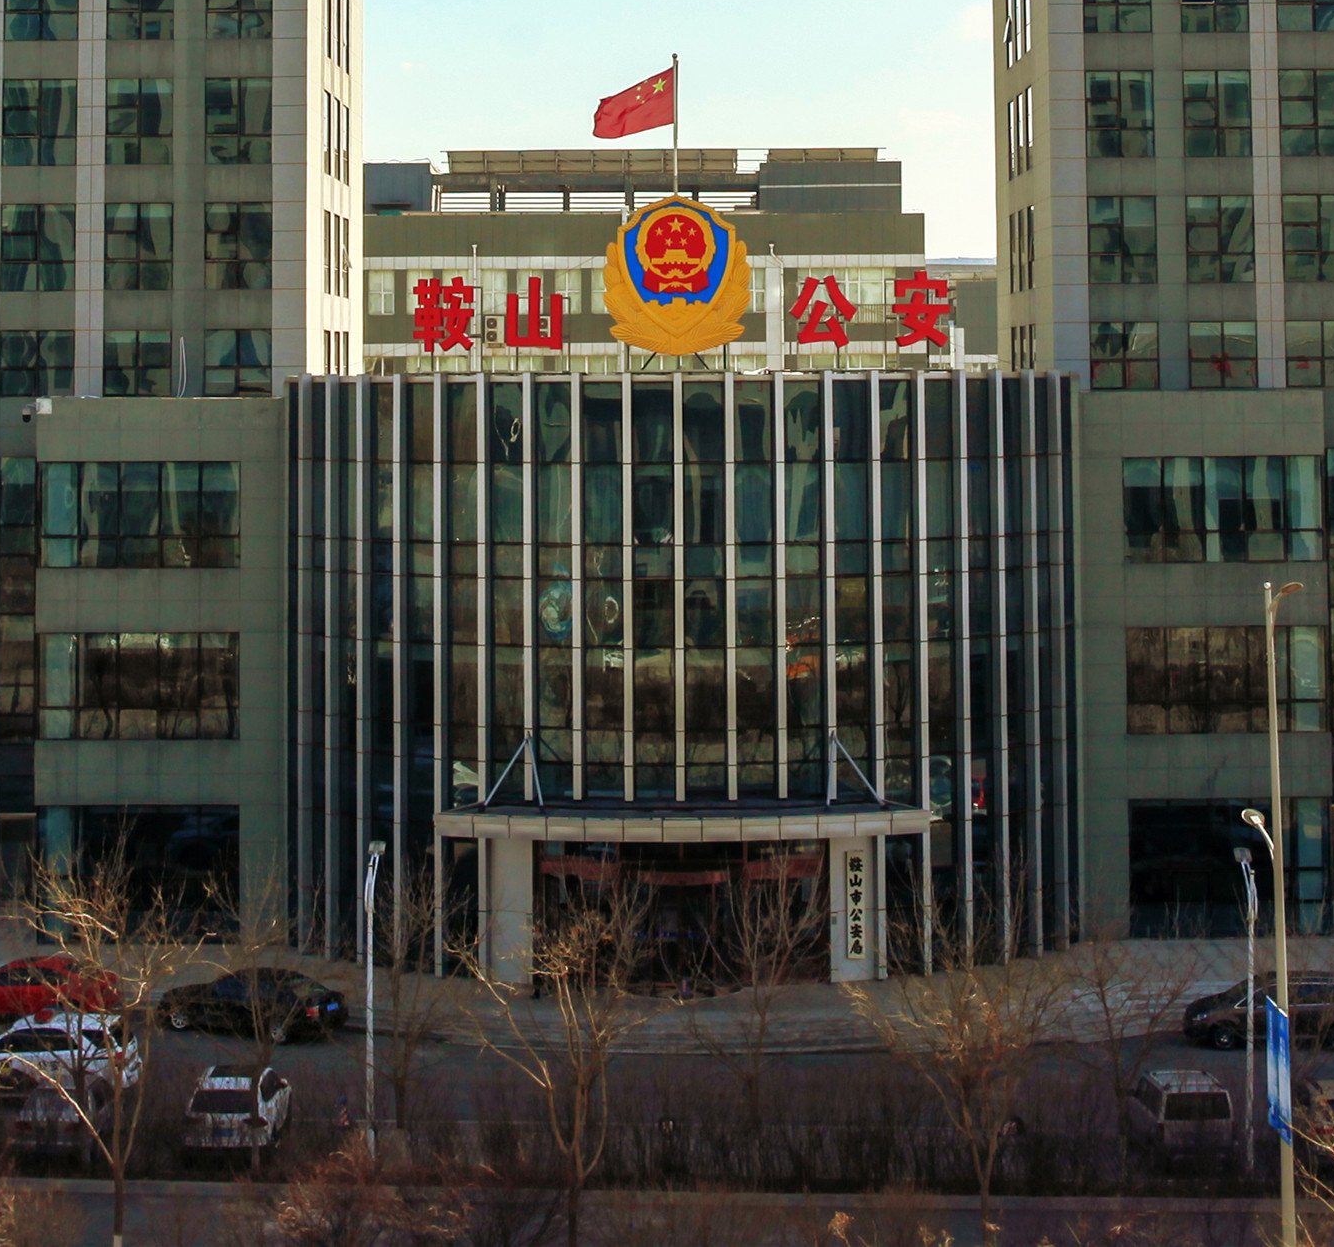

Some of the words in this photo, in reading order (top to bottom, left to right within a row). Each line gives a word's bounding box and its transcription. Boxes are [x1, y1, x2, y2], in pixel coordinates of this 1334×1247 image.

[413, 276, 563, 352] 鞍山
[789, 270, 950, 348] 公安
[849, 856, 863, 956] 鞍山市公安局
